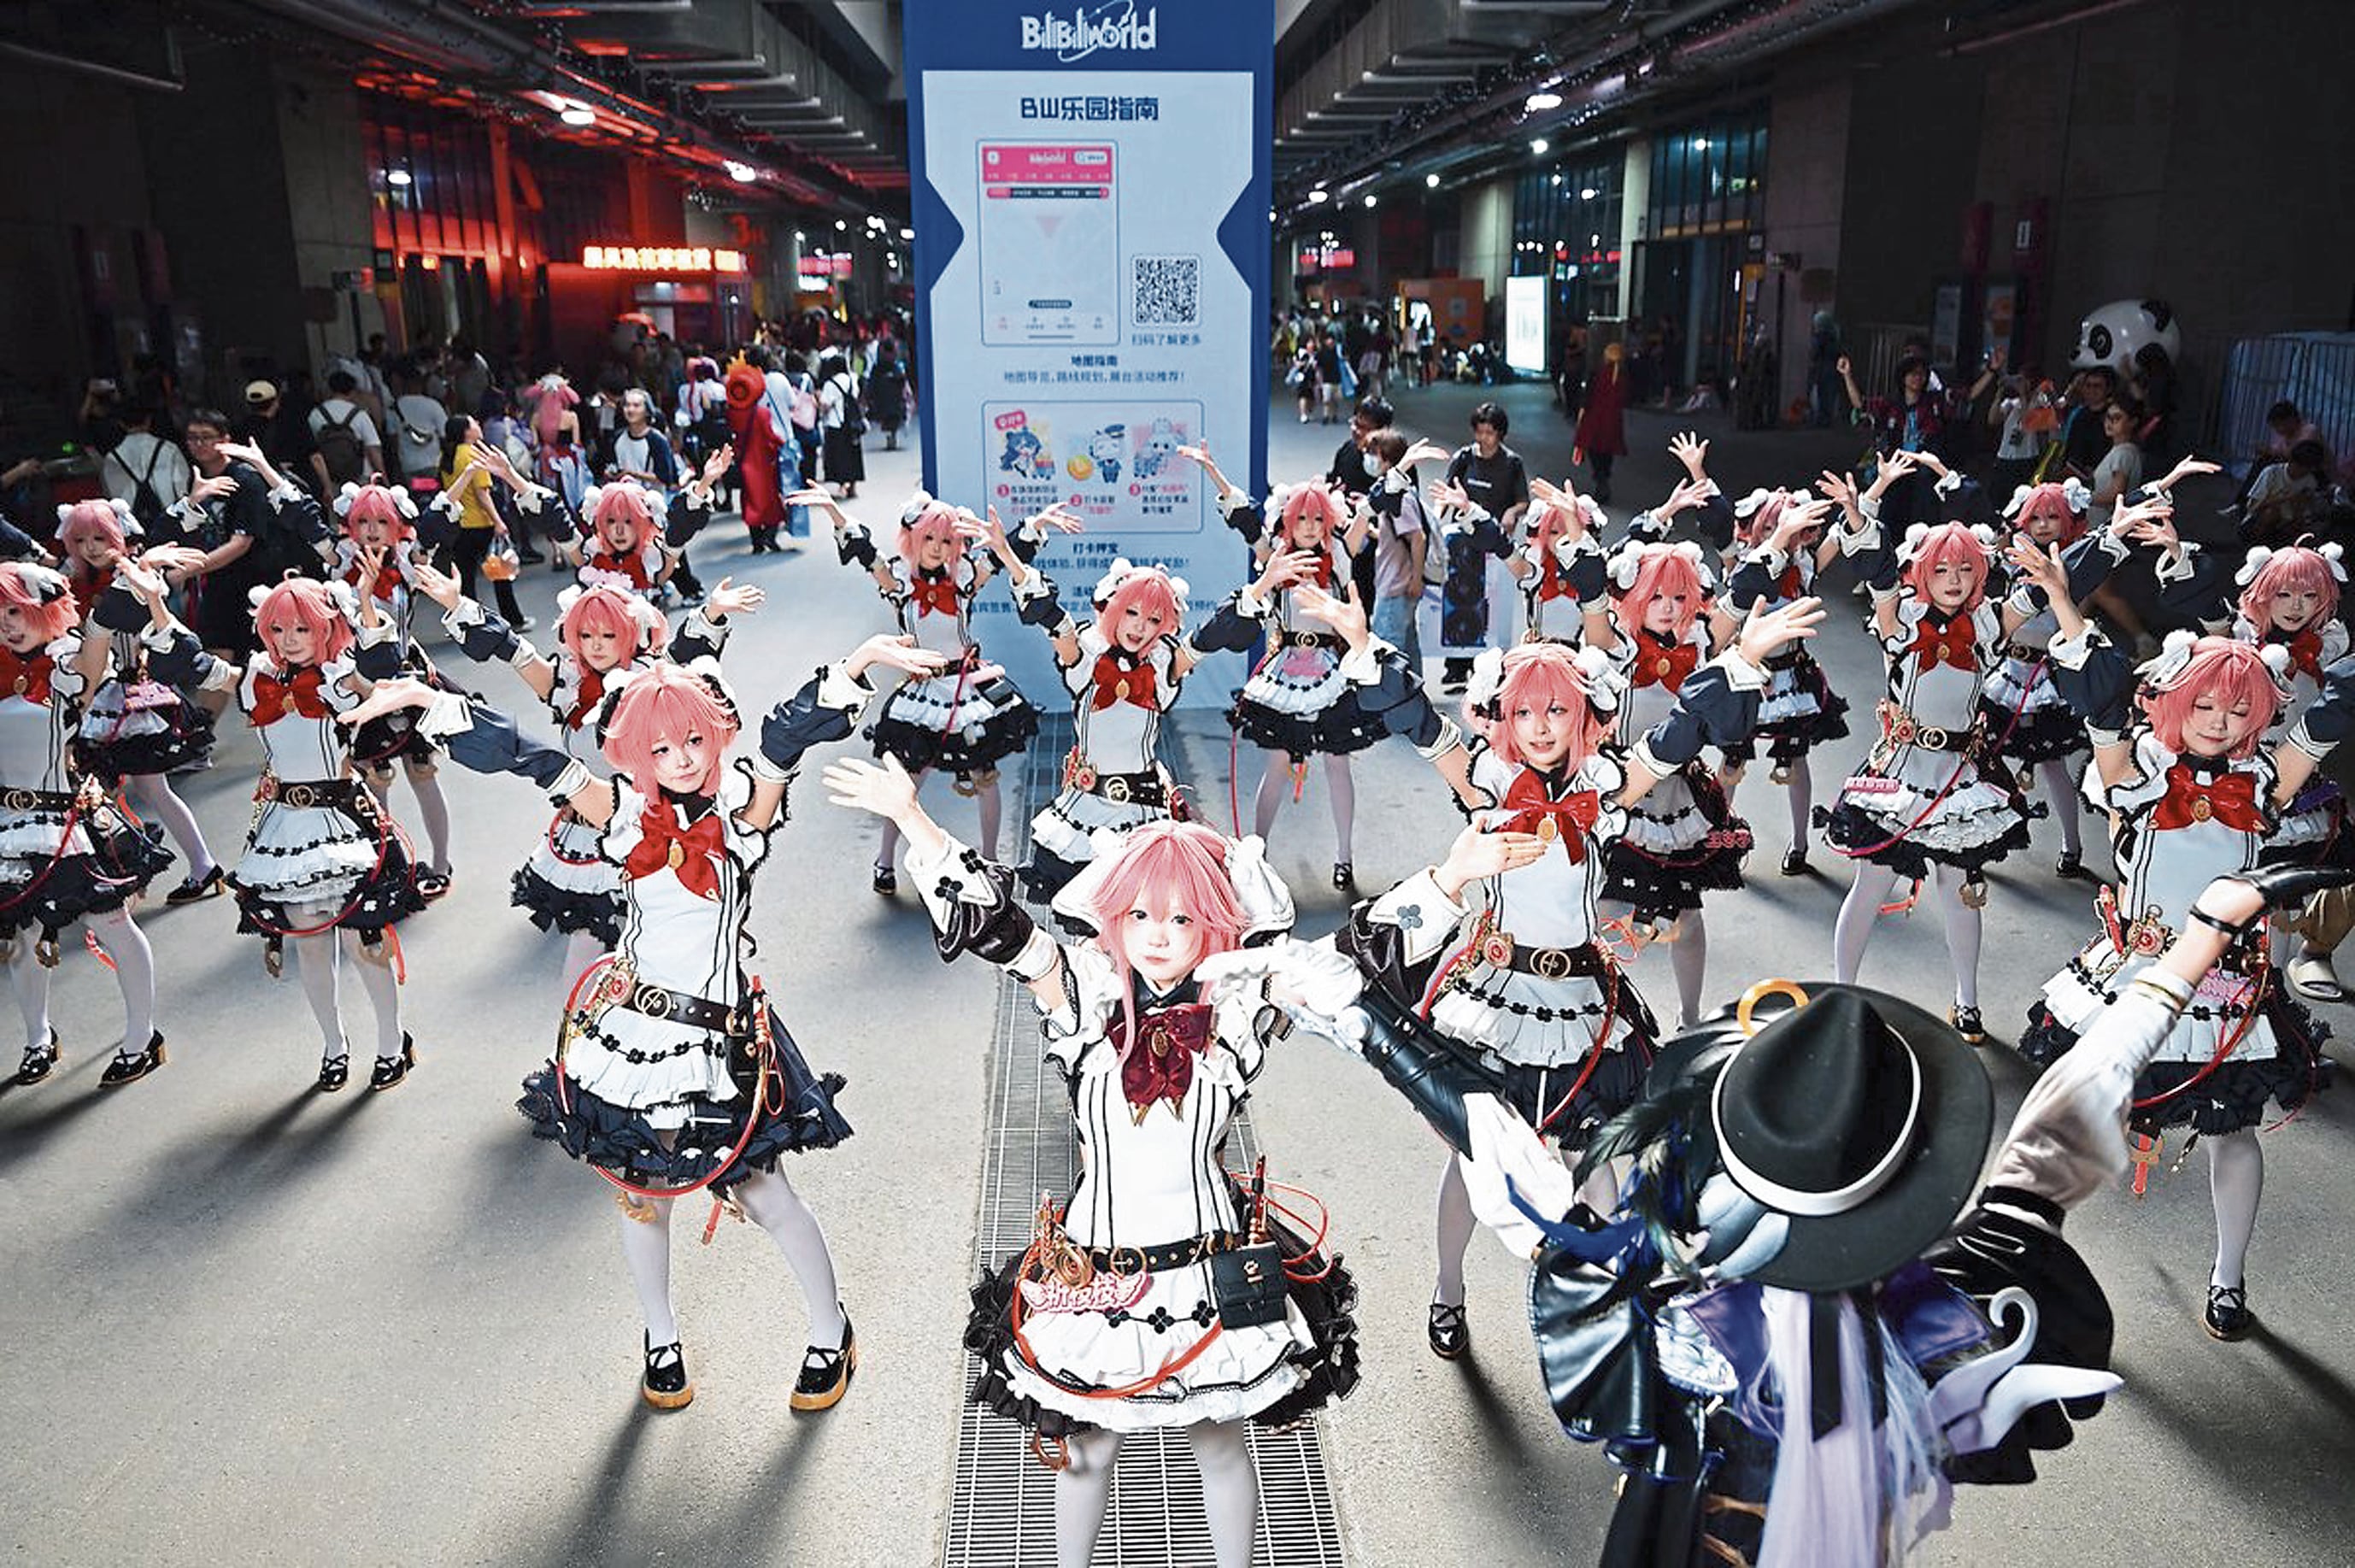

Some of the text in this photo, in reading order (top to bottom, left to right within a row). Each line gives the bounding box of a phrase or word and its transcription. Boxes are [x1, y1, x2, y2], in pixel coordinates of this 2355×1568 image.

[1020, 96, 1160, 121] BW乐园指南
[1131, 333, 1201, 346] 扫码了解更多
[1071, 355, 1119, 367] 地图指南
